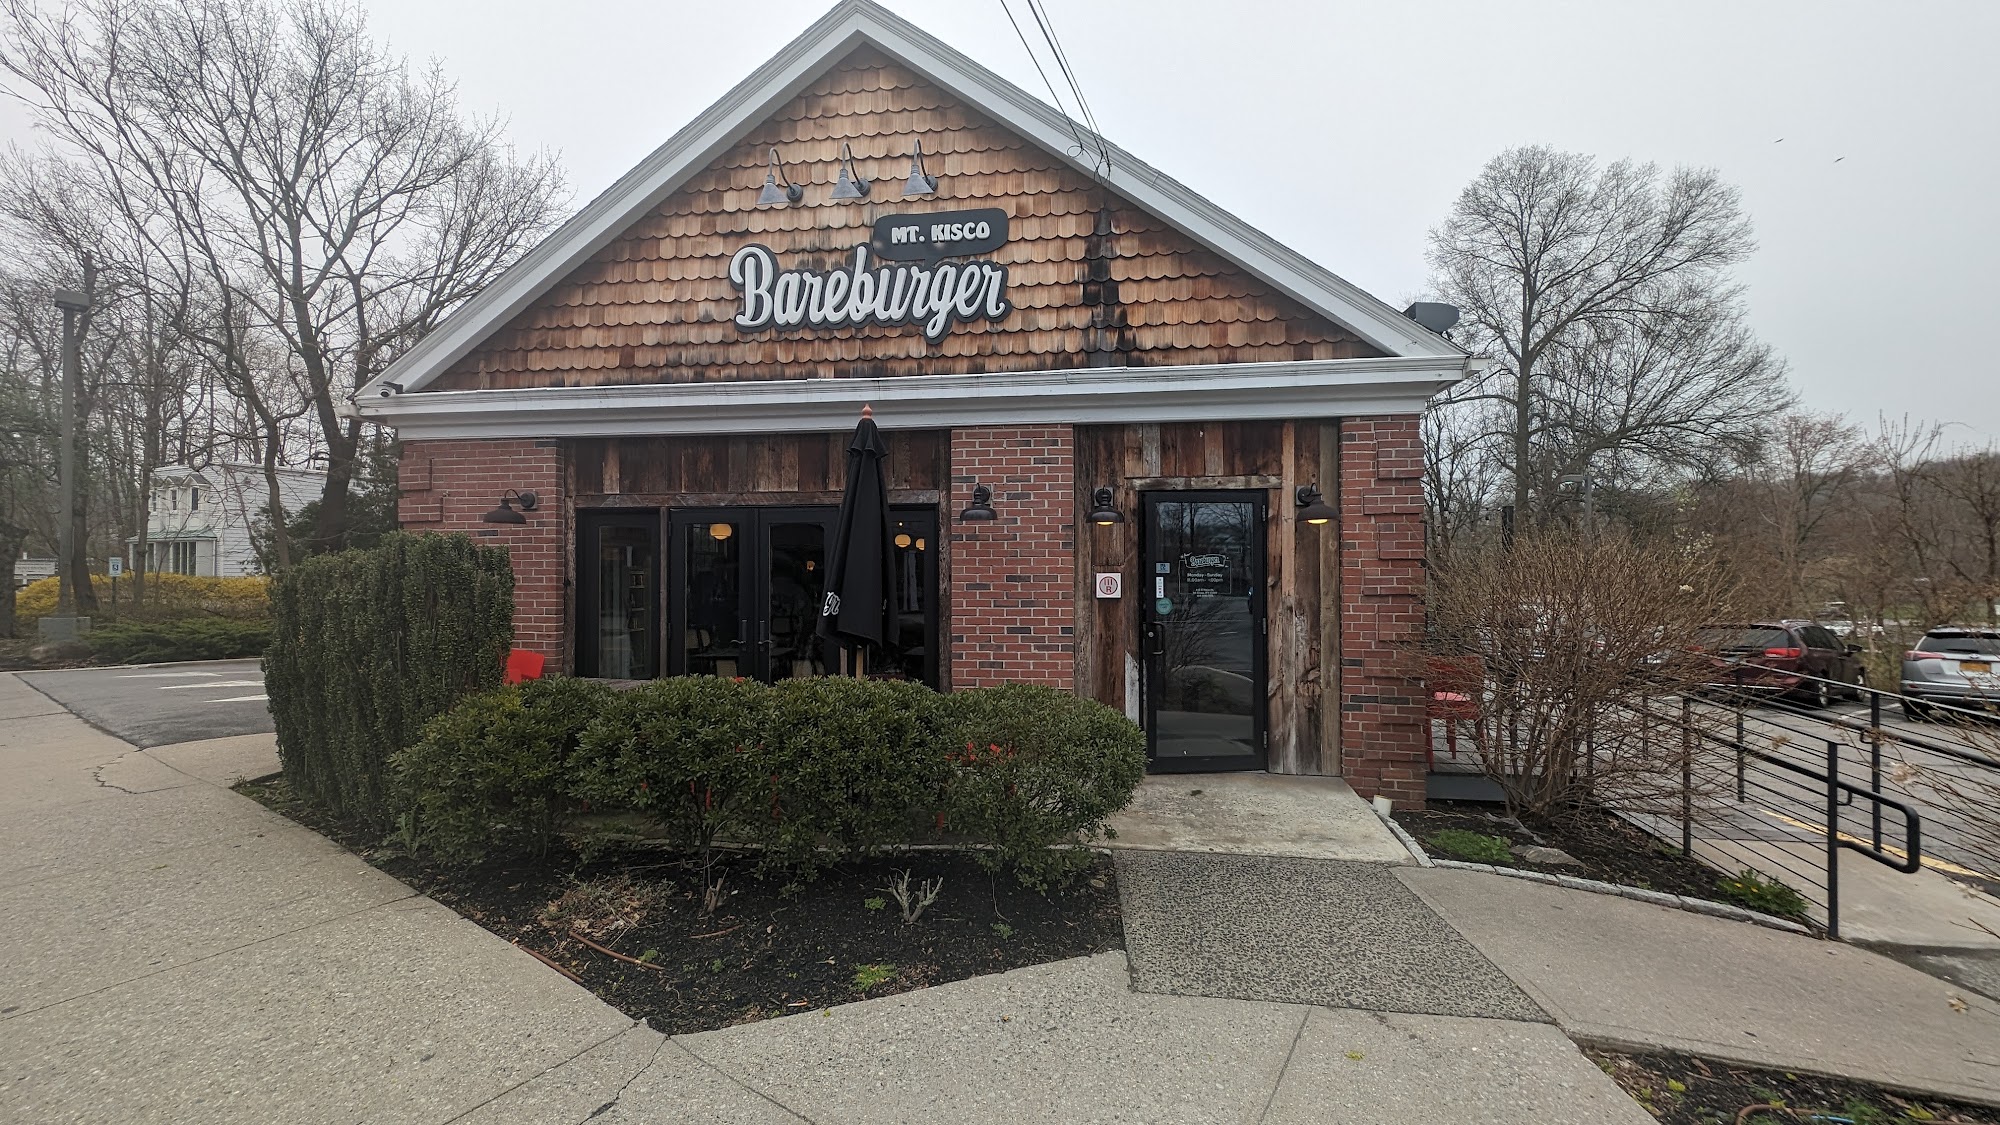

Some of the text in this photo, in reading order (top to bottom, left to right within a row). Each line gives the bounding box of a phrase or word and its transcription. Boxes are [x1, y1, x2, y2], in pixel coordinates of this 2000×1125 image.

[891, 221, 991, 244] MT. KISCO
[729, 246, 1006, 338] Bareburger
